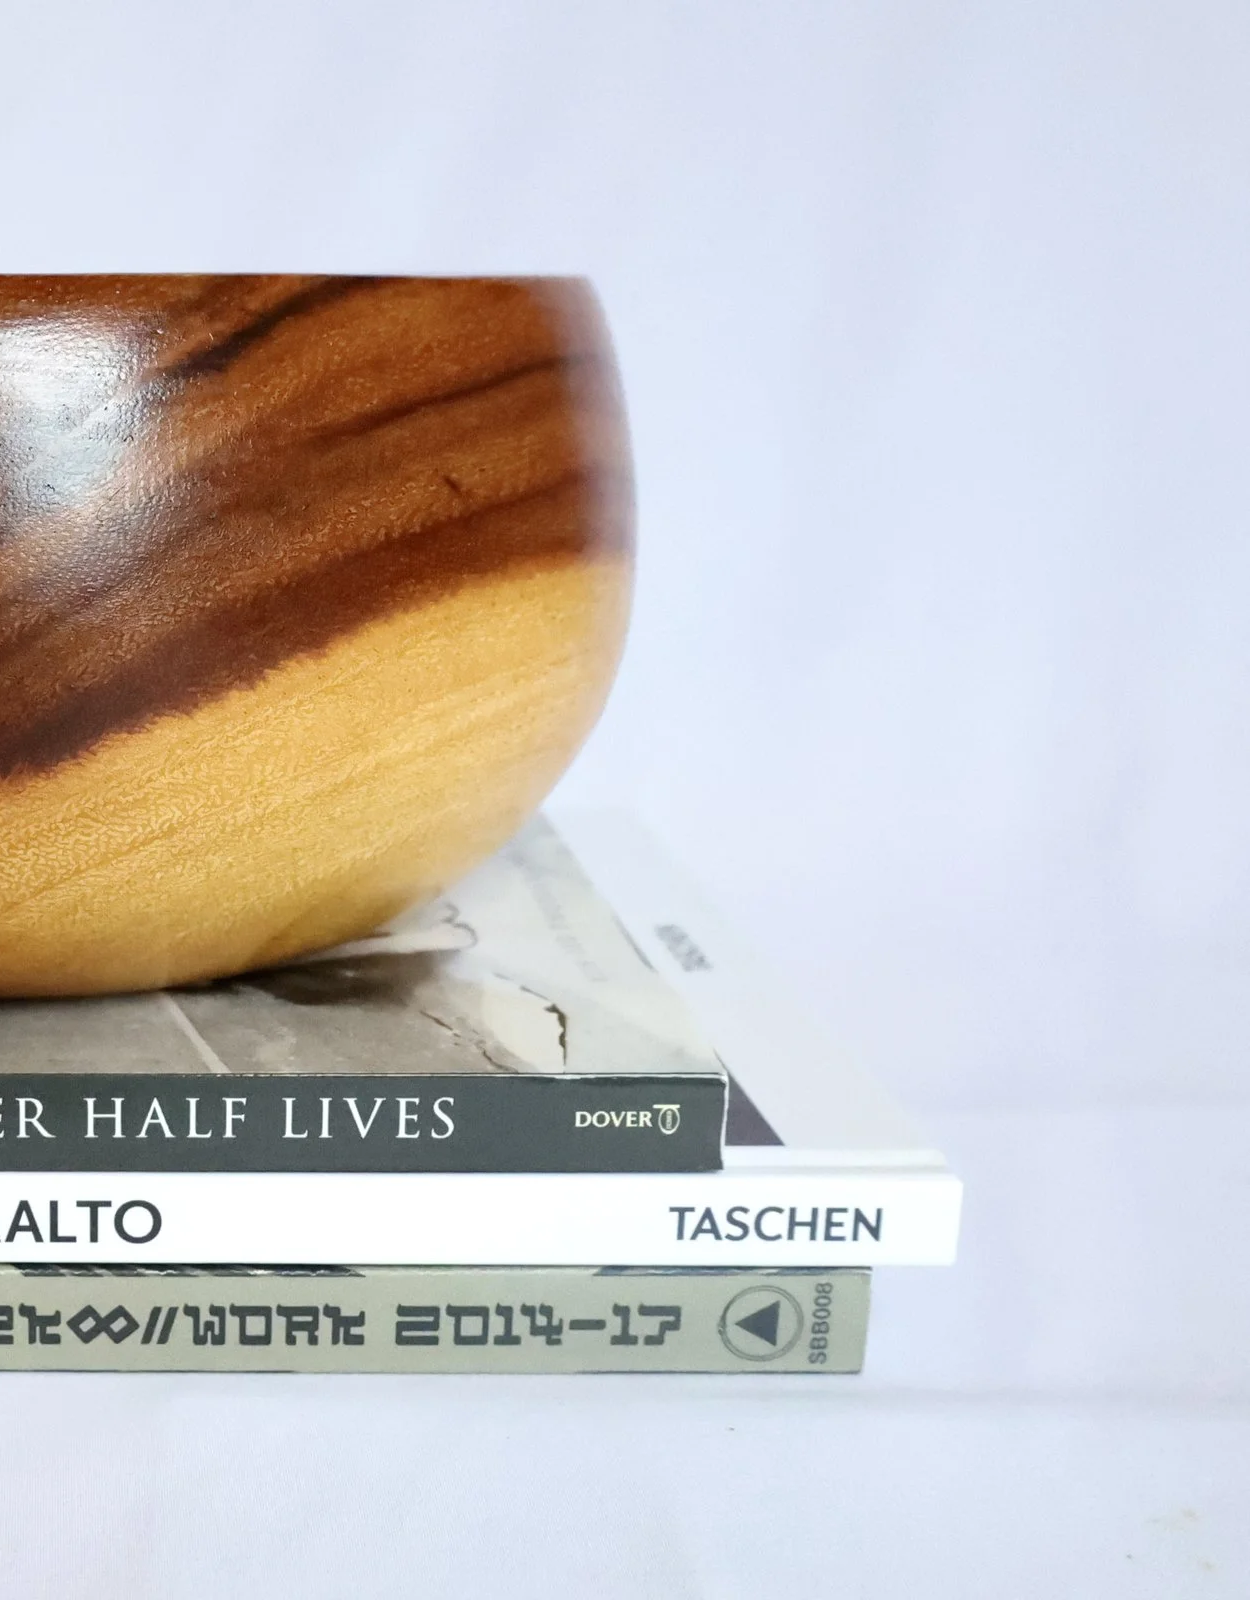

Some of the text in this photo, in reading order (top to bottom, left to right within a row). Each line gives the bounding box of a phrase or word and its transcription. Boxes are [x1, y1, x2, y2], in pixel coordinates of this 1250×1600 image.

[83, 1096, 248, 1139] HALF
[281, 1096, 456, 1140] LIVES
[574, 1110, 653, 1128] DOVER
[668, 1205, 884, 1243] TASCHEN
[394, 1302, 683, 1346] 2014-17
[807, 1281, 834, 1365] SBB008
